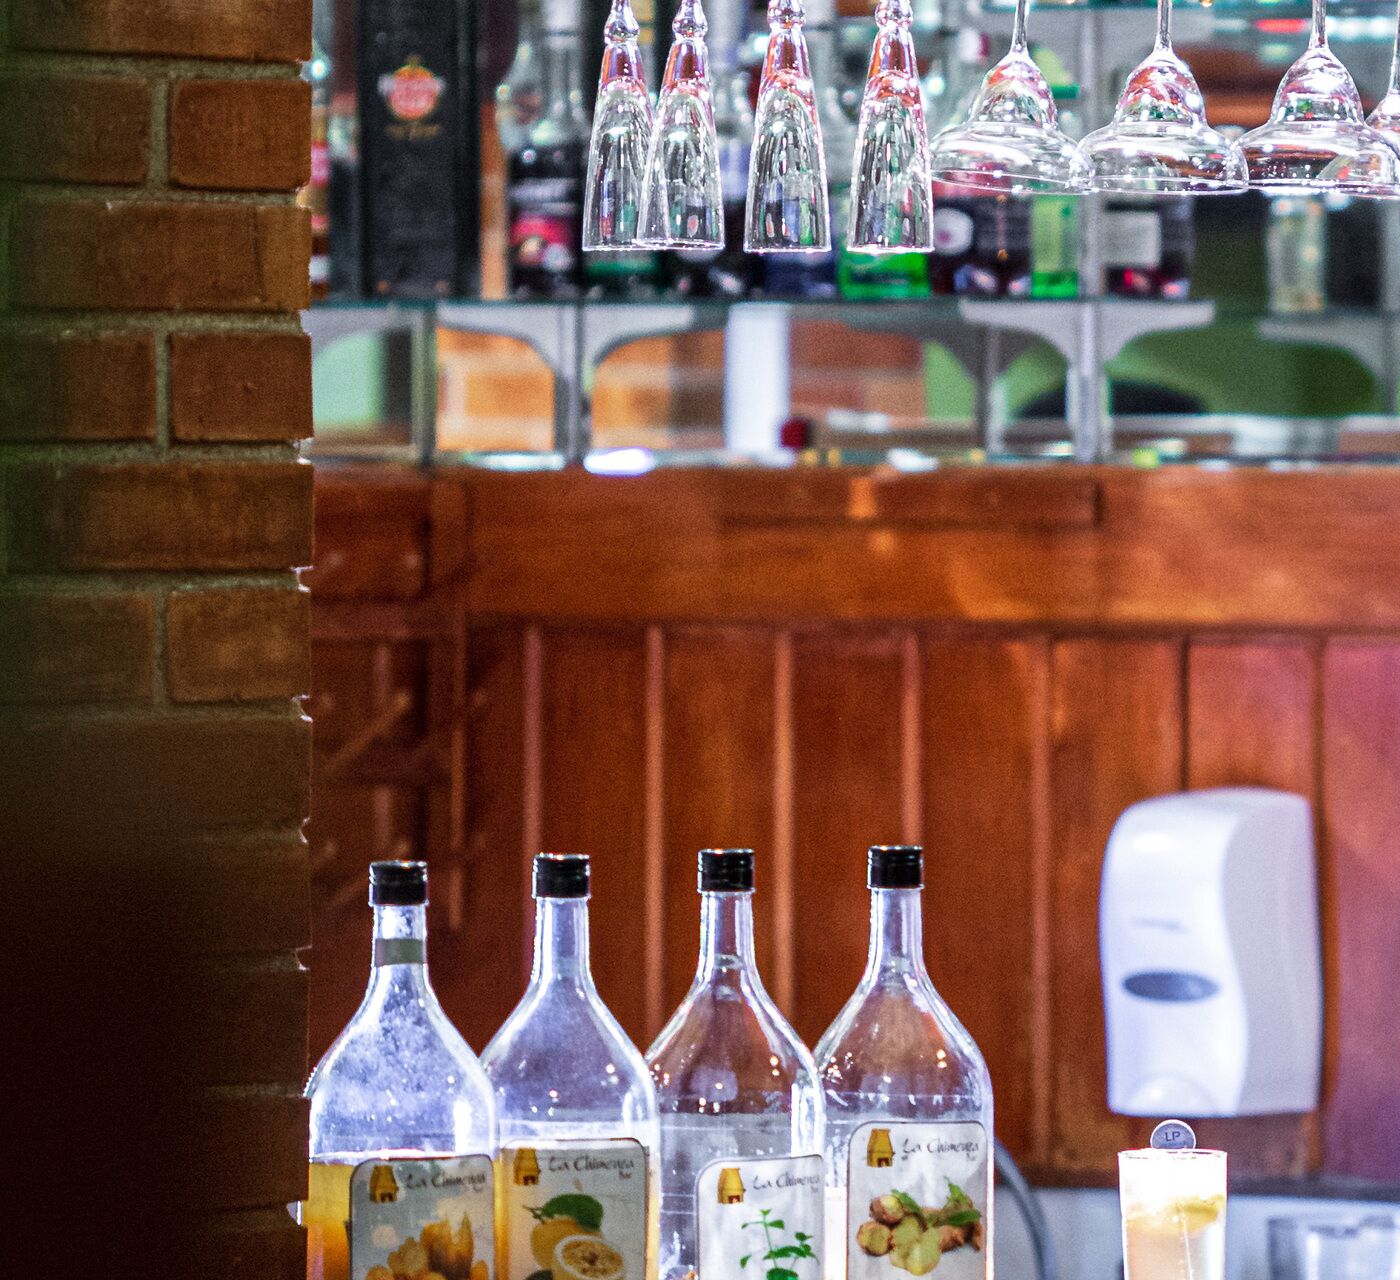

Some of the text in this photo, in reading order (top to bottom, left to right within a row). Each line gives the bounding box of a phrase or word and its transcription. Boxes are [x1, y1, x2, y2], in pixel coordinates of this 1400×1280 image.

[1165, 1131, 1181, 1141] LP
[902, 1138, 921, 1154] La
[548, 1156, 569, 1172] La
[406, 1173, 427, 1190] La
[753, 1175, 773, 1191] La
